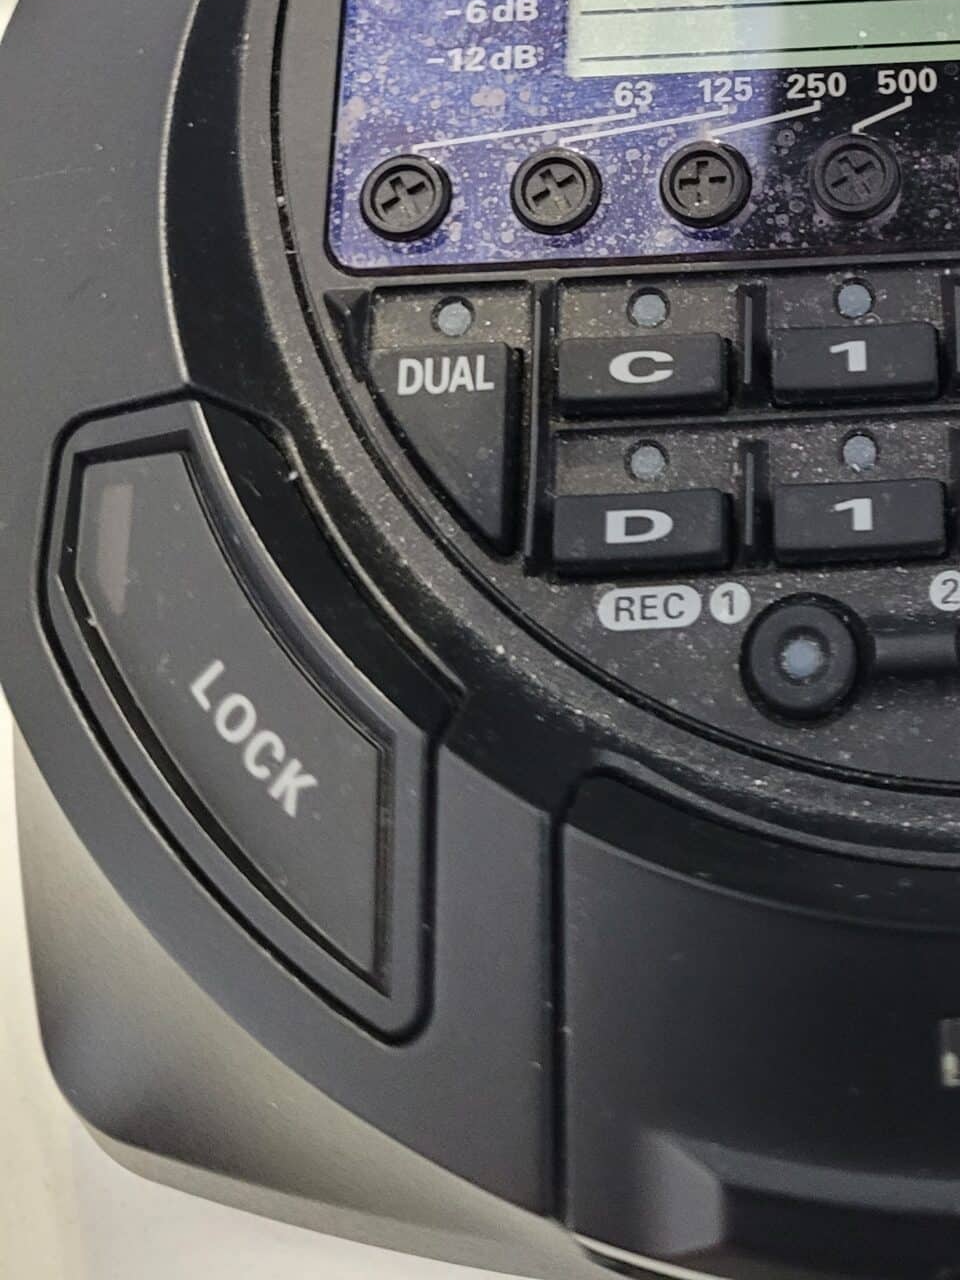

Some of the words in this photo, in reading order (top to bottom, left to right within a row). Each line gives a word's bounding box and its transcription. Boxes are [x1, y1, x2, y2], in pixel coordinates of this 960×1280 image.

[613, 81, 655, 107] 63
[700, 77, 753, 104] 125
[786, 72, 848, 100] 250
[877, 68, 938, 95] 500
[608, 350, 674, 384] C
[828, 340, 868, 373] 1
[396, 354, 495, 397] DUAL
[604, 509, 674, 545] D
[833, 497, 874, 532] 1
[613, 593, 686, 623] REC
[190, 659, 319, 817] LOCK
